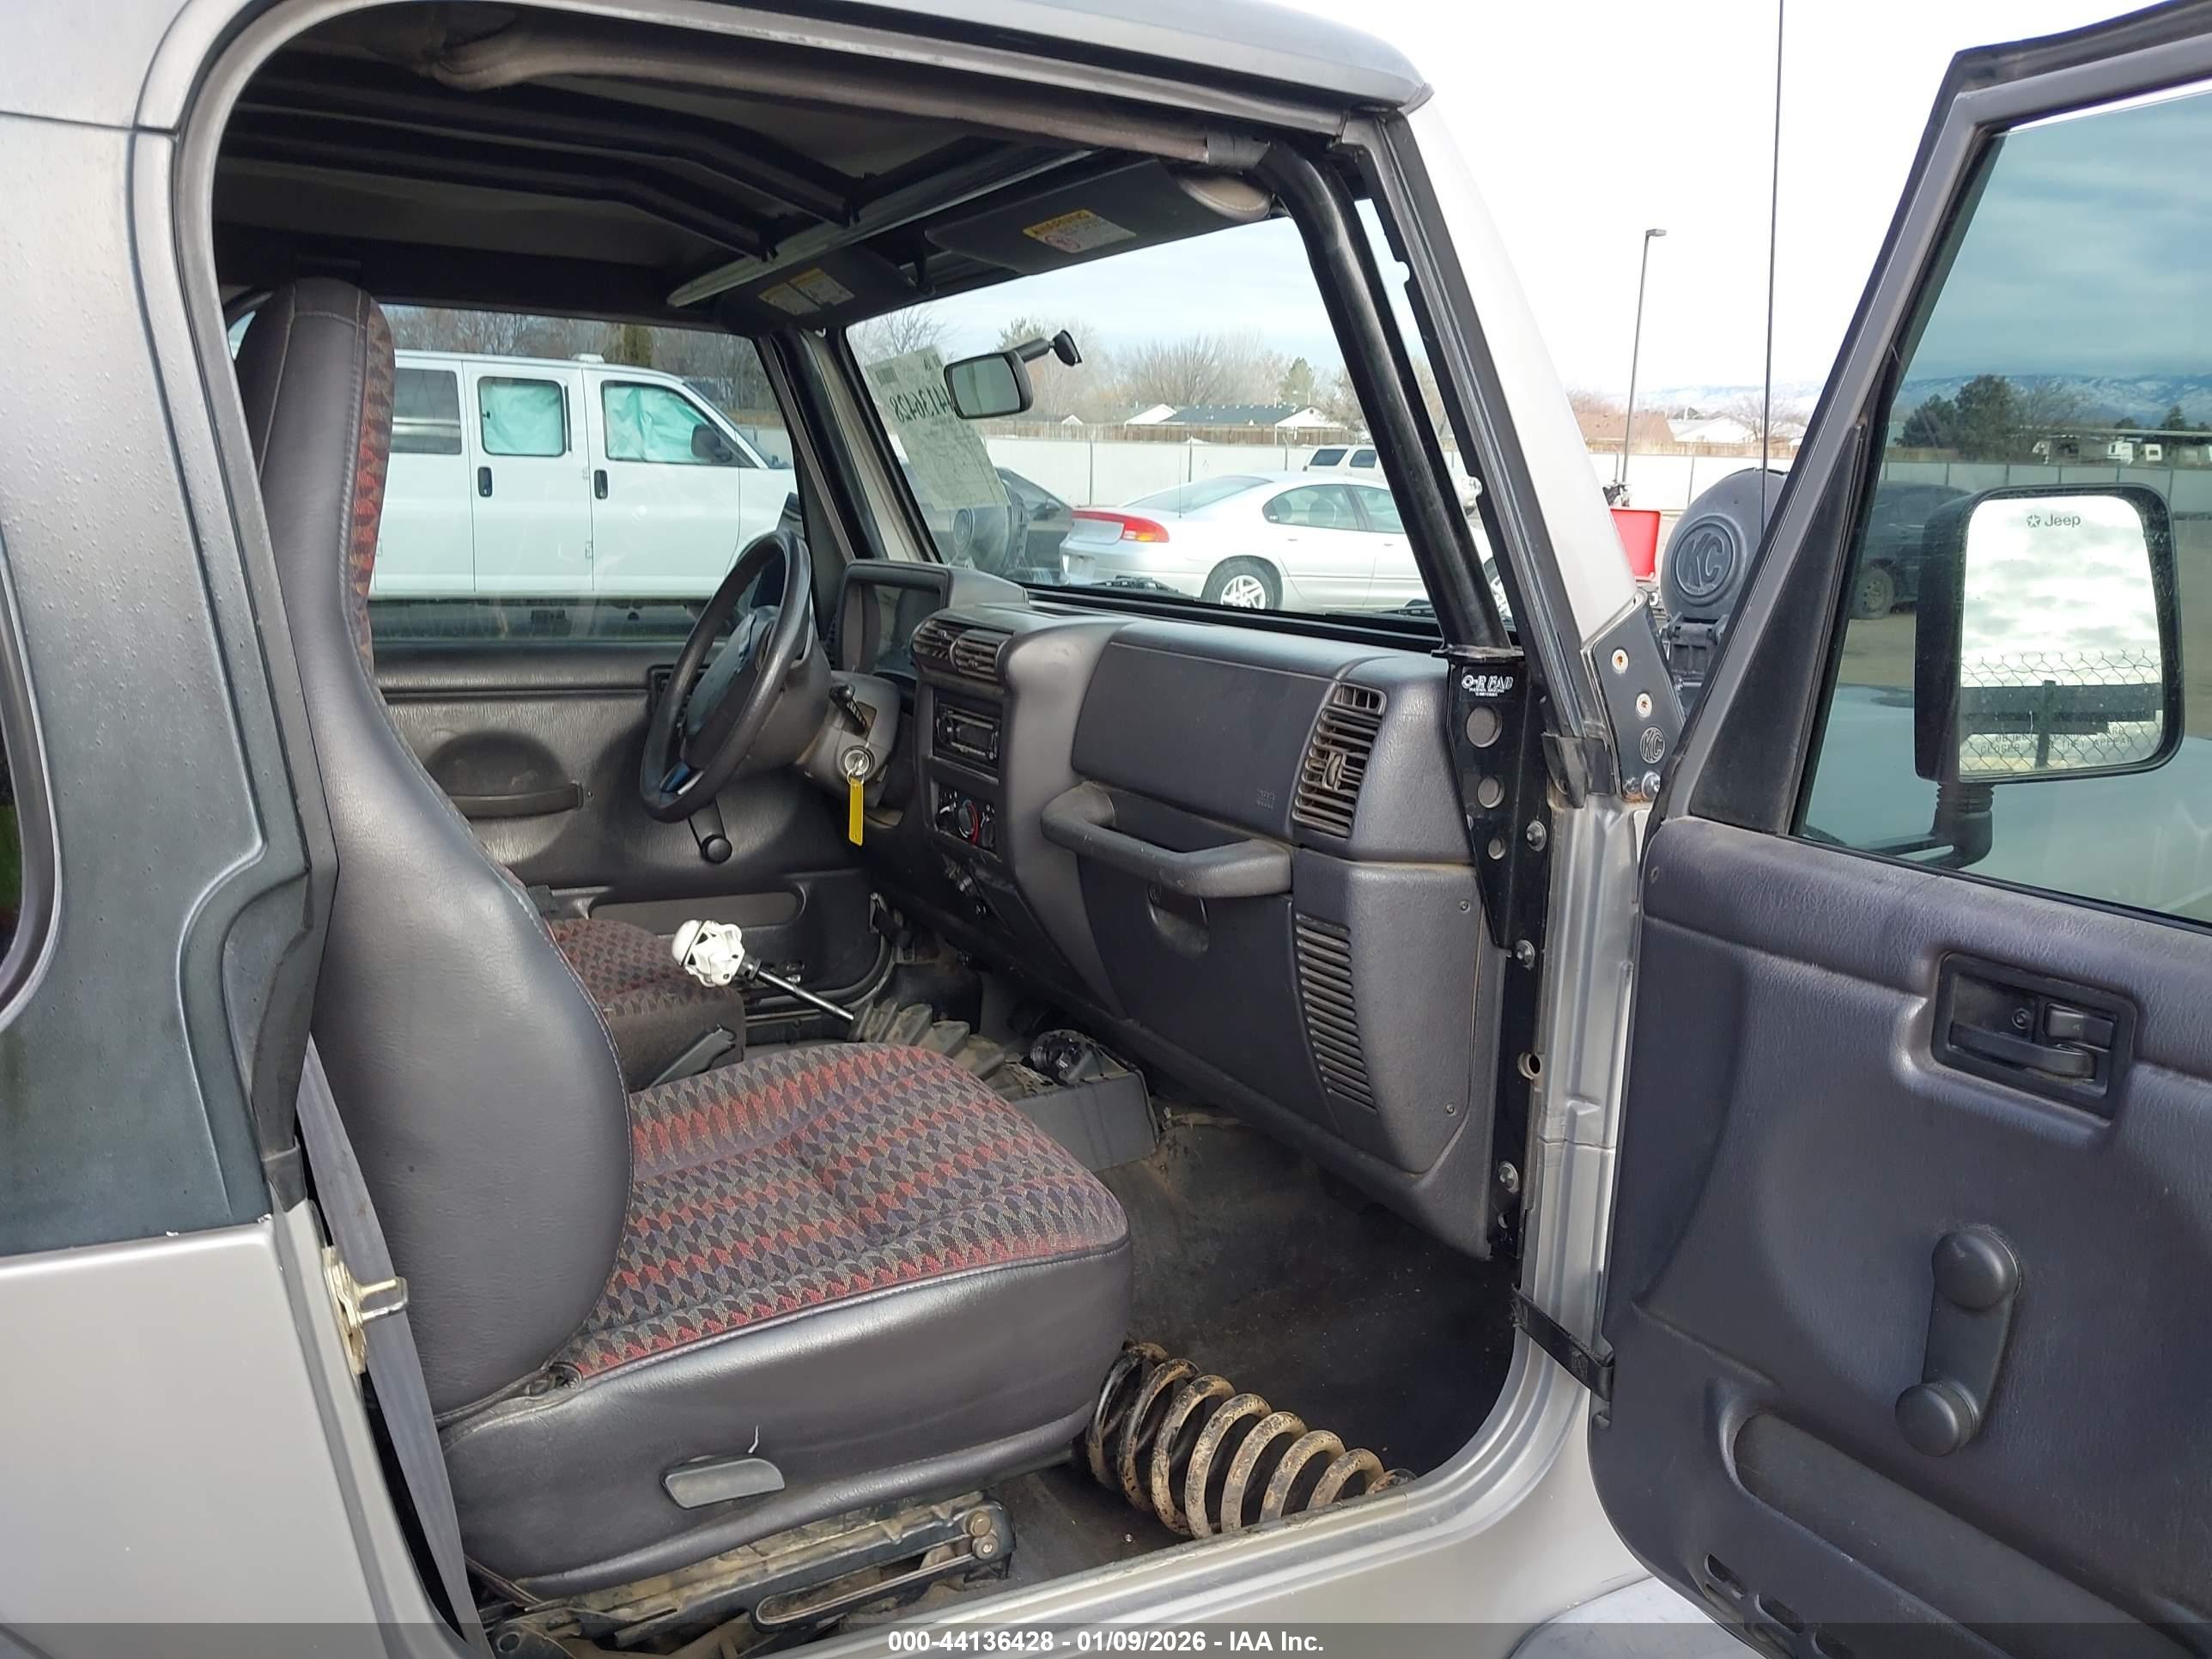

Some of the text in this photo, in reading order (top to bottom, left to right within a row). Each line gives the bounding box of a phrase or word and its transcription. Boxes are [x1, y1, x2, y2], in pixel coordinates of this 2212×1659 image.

[2044, 514, 2081, 528] Jeep
[1684, 532, 1725, 587] KC
[1642, 728, 1663, 763] KC
